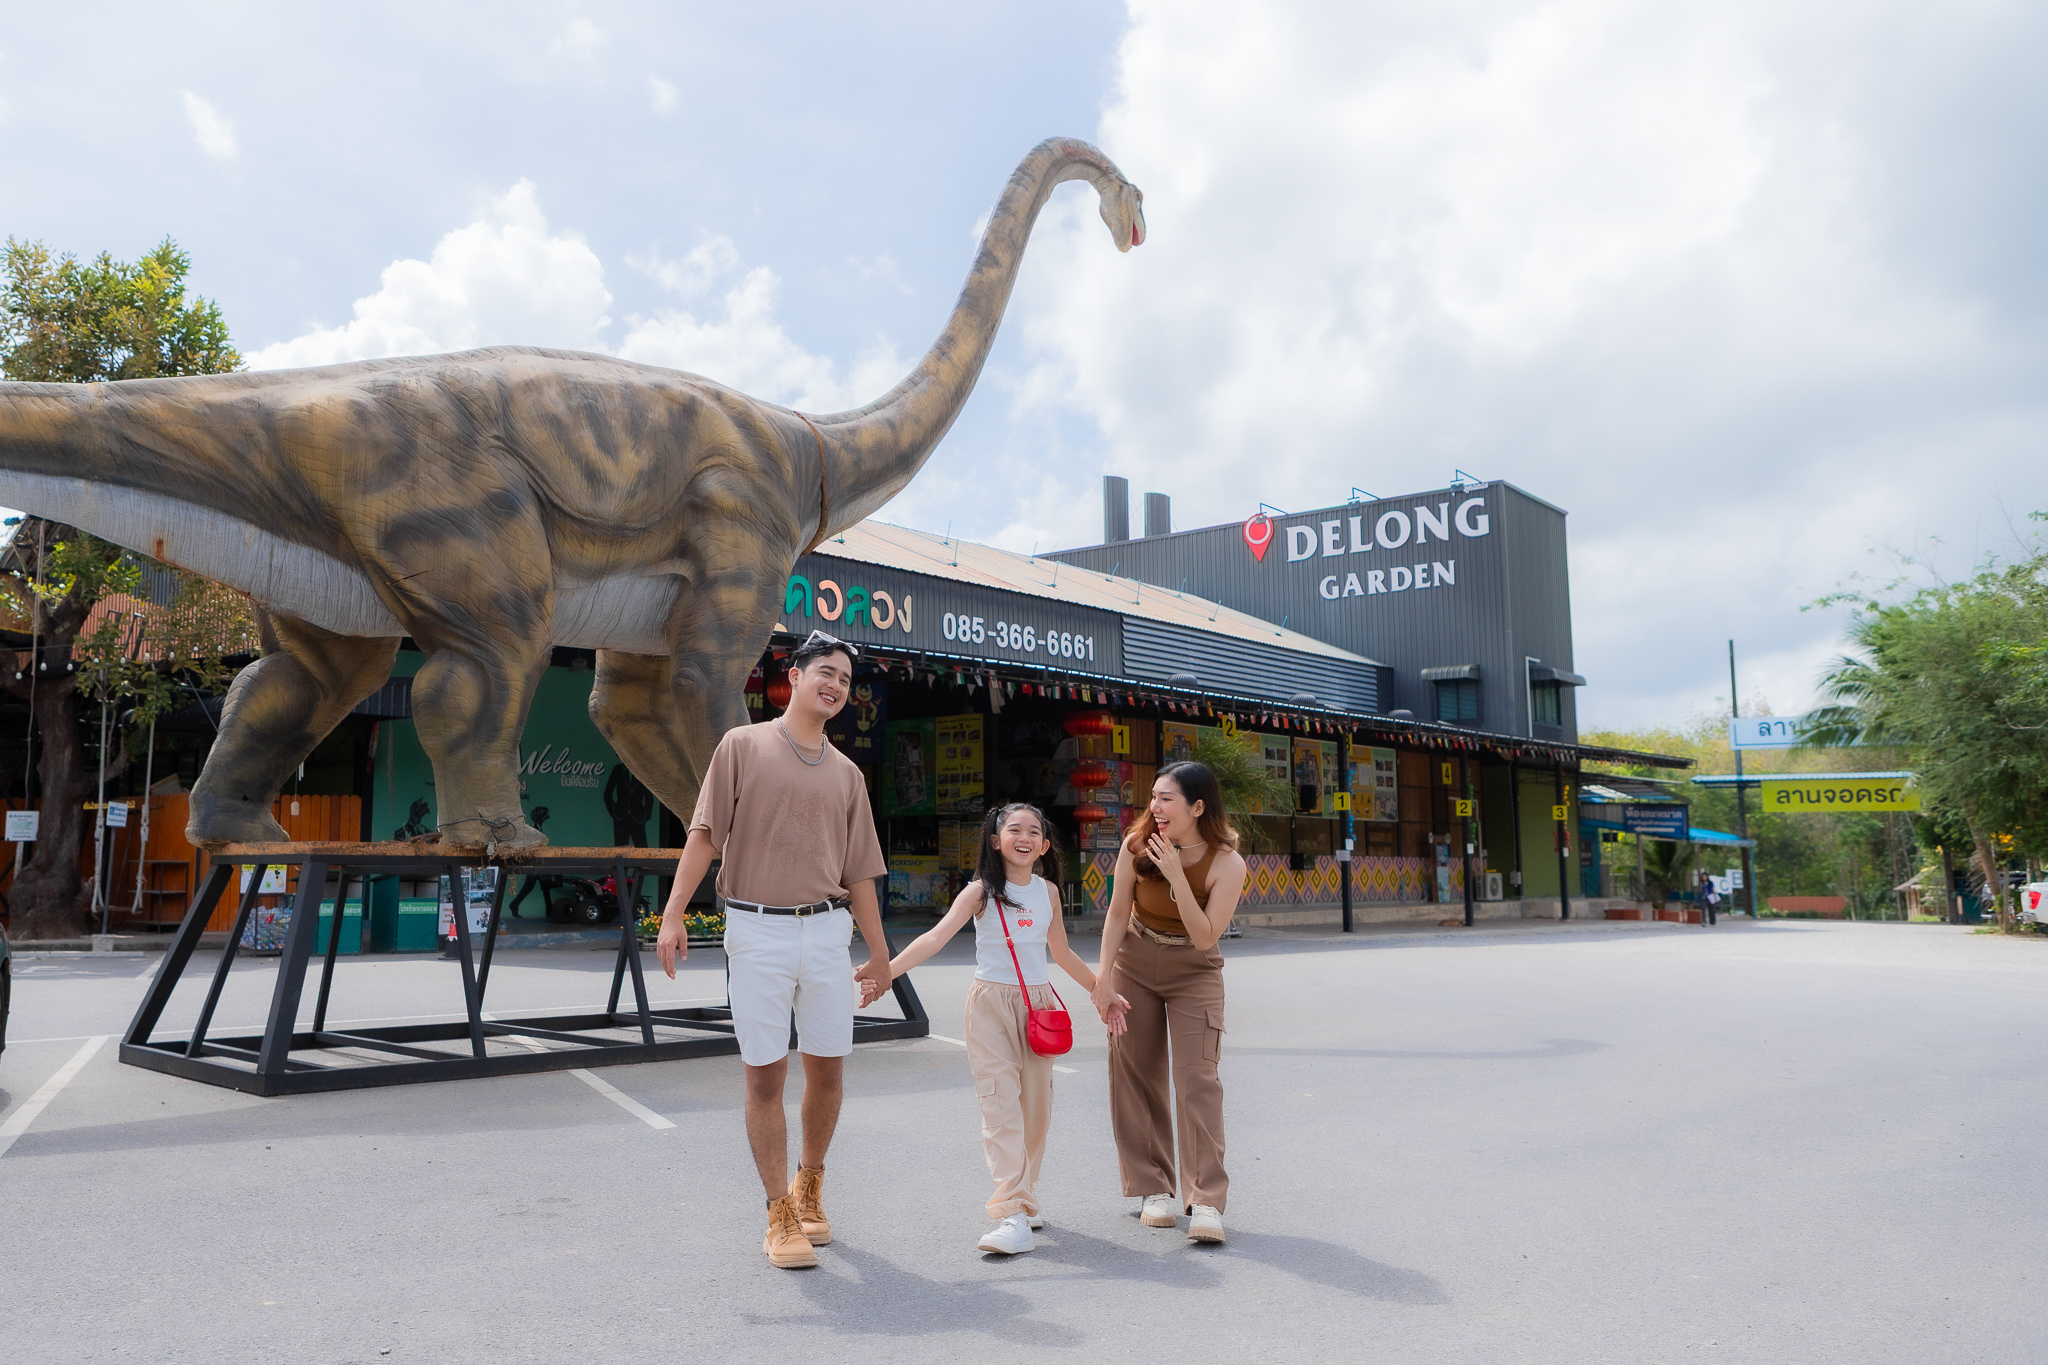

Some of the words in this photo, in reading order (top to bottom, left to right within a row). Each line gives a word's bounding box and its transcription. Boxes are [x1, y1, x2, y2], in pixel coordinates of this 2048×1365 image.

[1286, 497, 1490, 563] DELONG
[1319, 559, 1456, 600] GARDEN
[943, 612, 1095, 662] 085-366-6661
[1226, 718, 1233, 737] 2
[1118, 728, 1124, 750] 1
[517, 744, 606, 775] Welcome
[560, 774, 599, 788] ยินดีต้อนรับ
[1444, 767, 1450, 782] 4
[1338, 795, 1345, 808] 1
[1776, 787, 1905, 804] ลานจอดรถ
[1460, 802, 1468, 814] 2
[1556, 808, 1564, 818] 3
[890, 859, 924, 867] WORKSHOP
[1720, 879, 1729, 891] C
